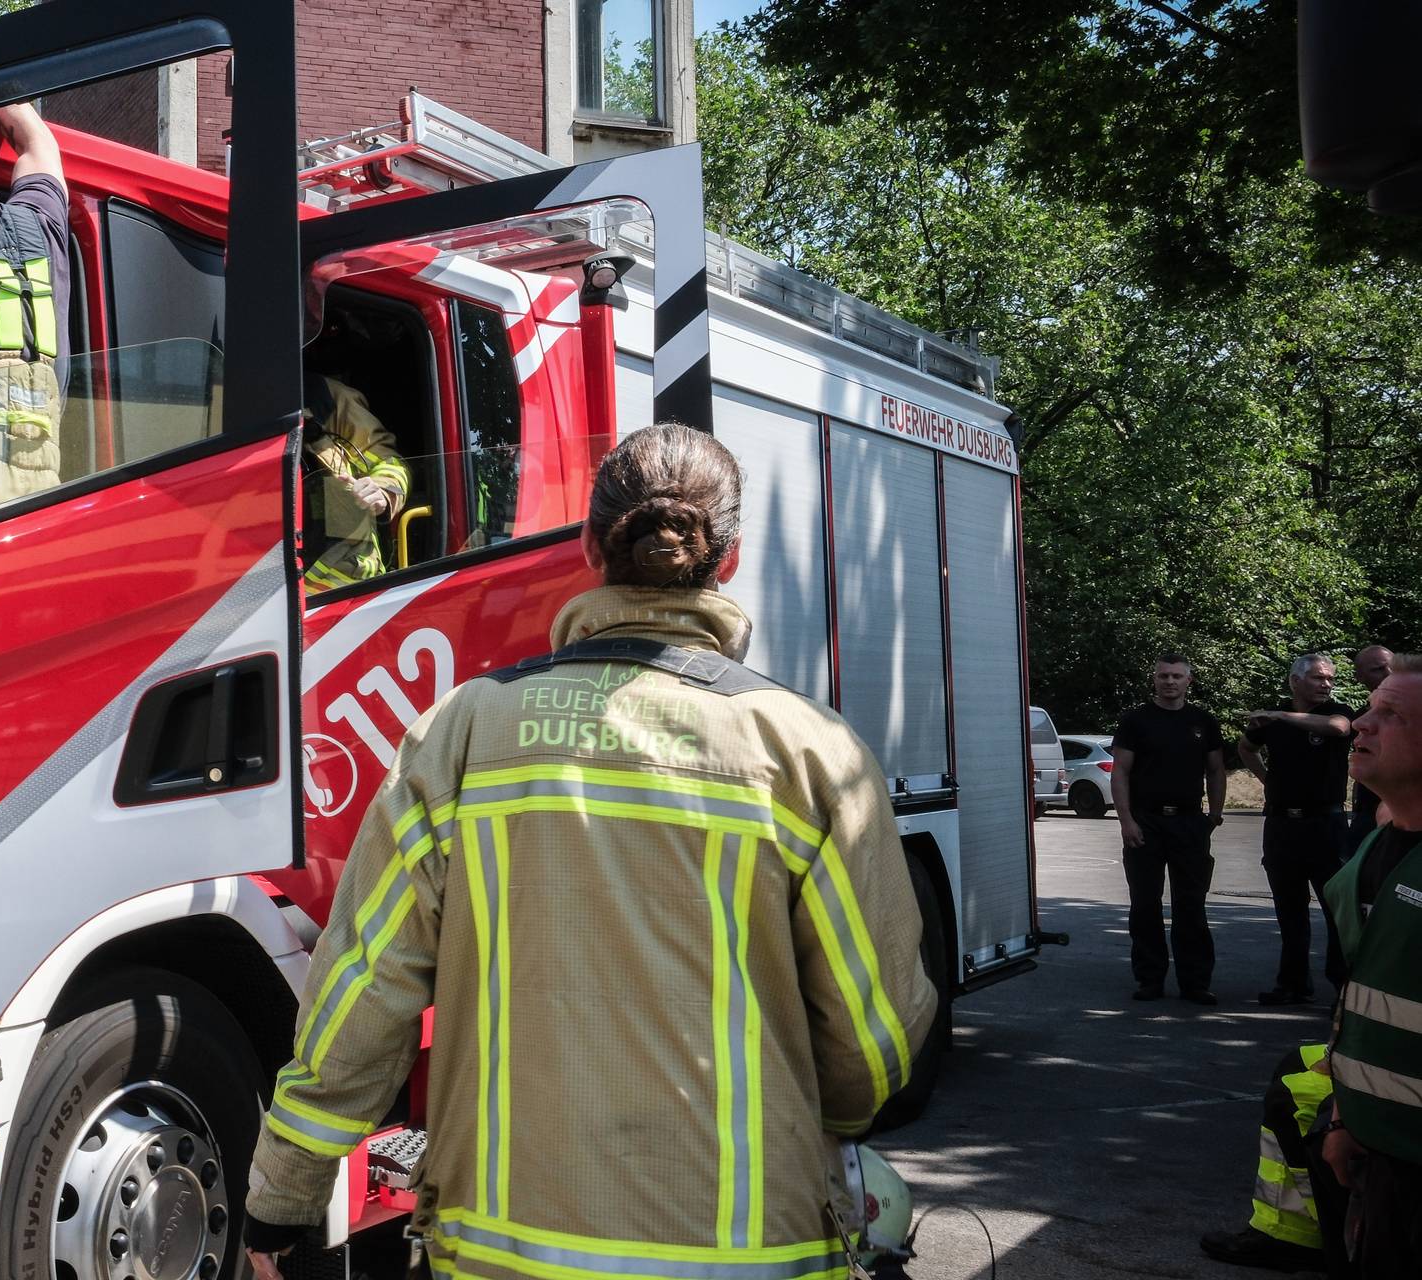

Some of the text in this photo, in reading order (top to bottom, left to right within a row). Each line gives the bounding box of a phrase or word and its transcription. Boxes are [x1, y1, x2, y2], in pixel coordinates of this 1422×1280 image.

[881, 395, 1012, 468] FEUERWEHR DUISBURG
[325, 627, 454, 770] 112
[521, 687, 699, 723] FEUERWEHR
[22, 1082, 83, 1251] Hybrid HS3
